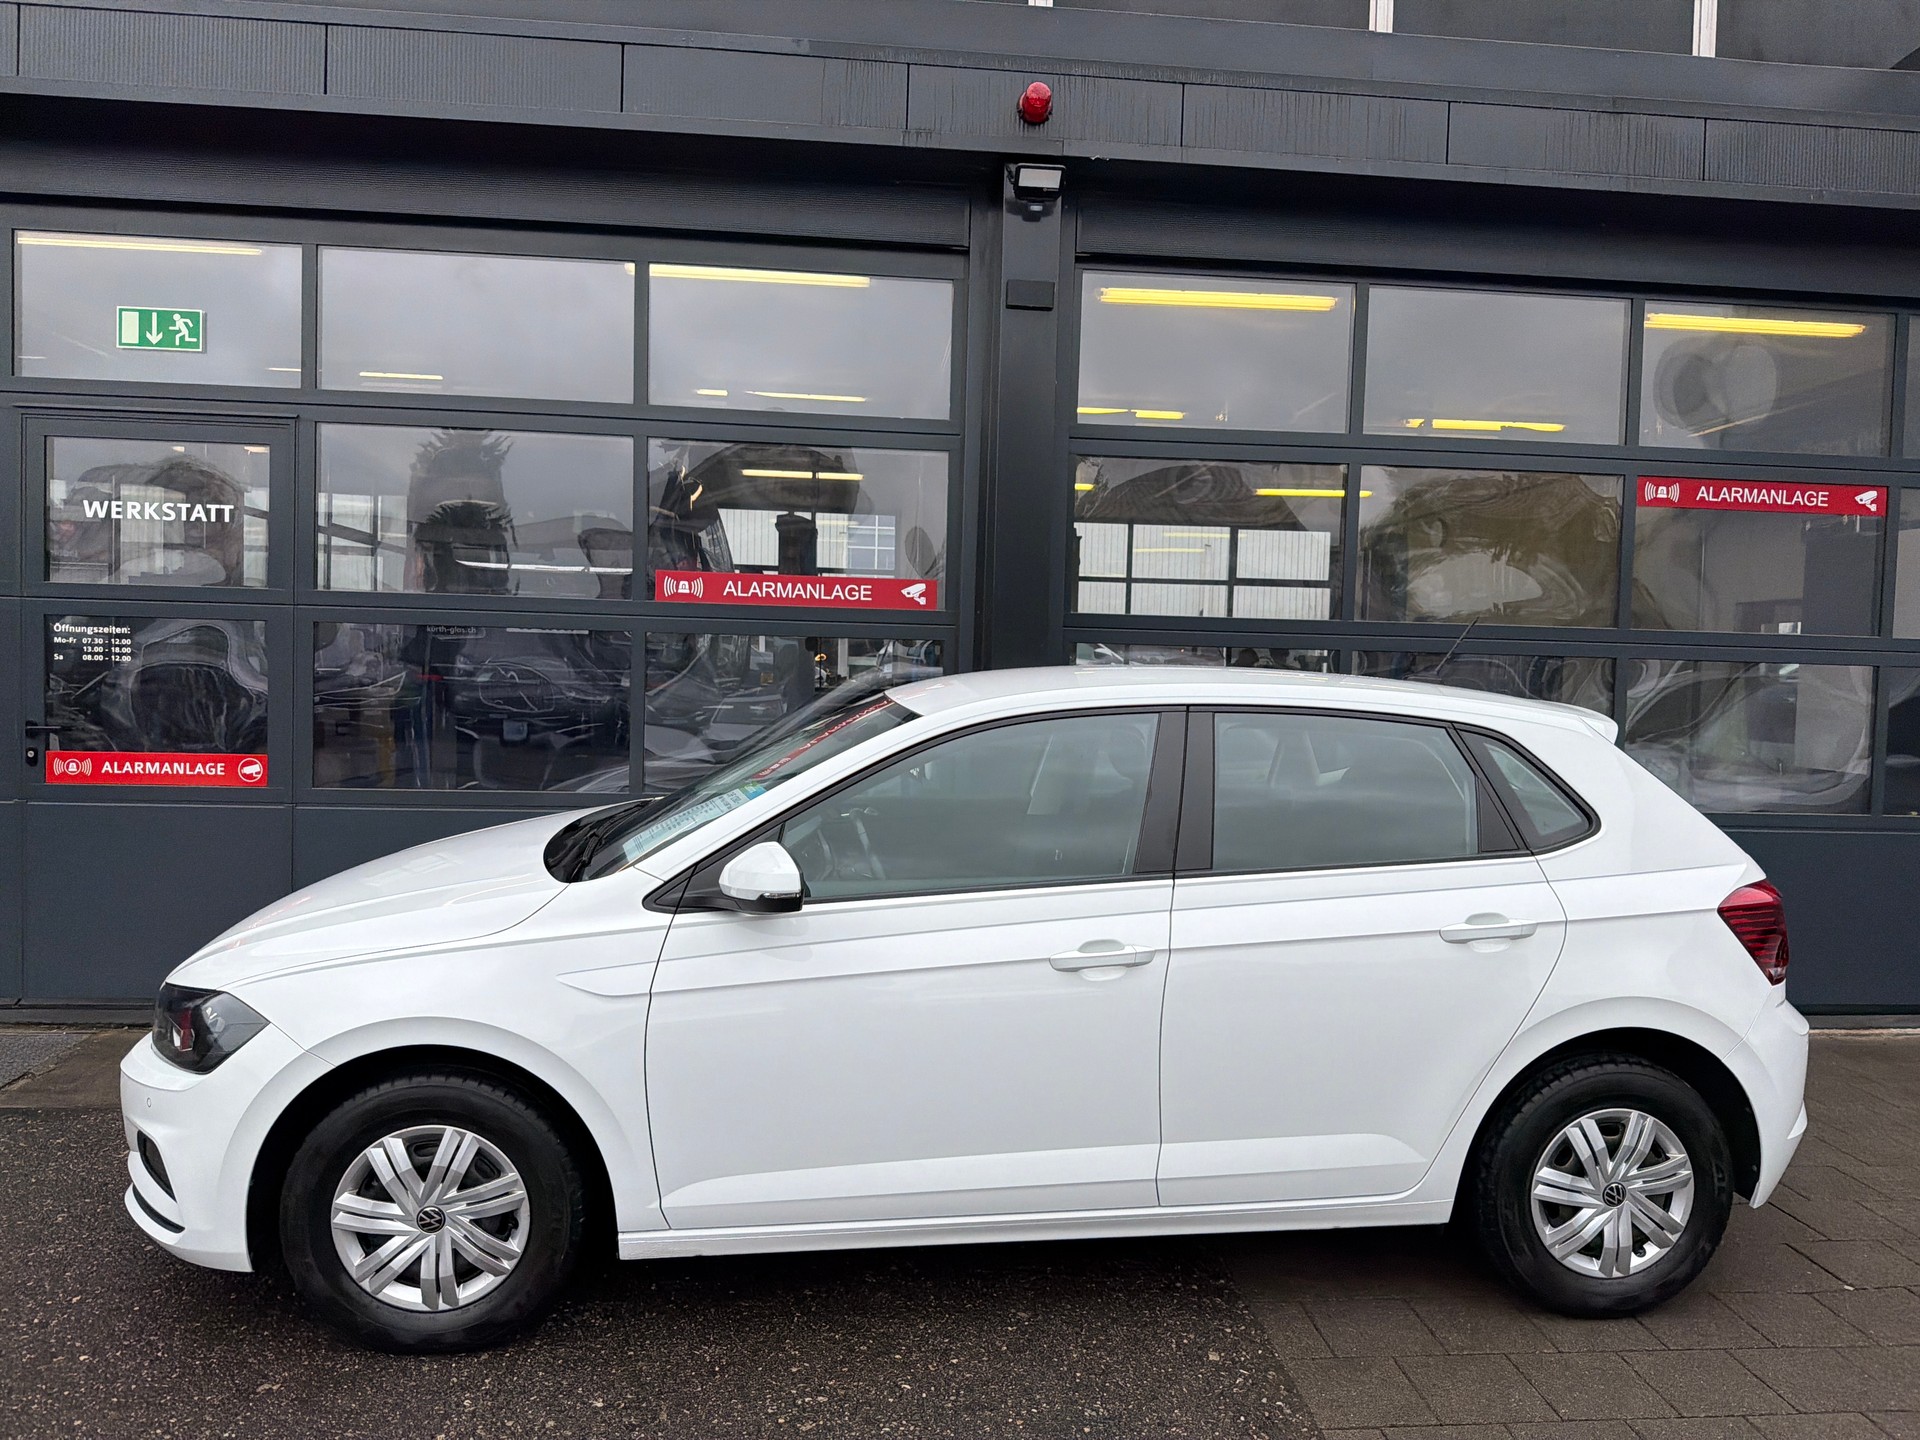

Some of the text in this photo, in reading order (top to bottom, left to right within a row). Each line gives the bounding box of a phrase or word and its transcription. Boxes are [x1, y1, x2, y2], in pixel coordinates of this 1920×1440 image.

[1696, 486, 1829, 507] ALARMANLAGE
[83, 500, 234, 522] WERKSTATT
[723, 580, 872, 601] ALARMANLAGE
[53, 622, 131, 635] Öffnungszeiten:
[53, 636, 77, 644] Mo-Fr
[82, 637, 104, 645] 07.30
[111, 638, 132, 646] 12.00
[53, 653, 64, 661] Sa
[101, 761, 226, 776] ALARMANLAGE
